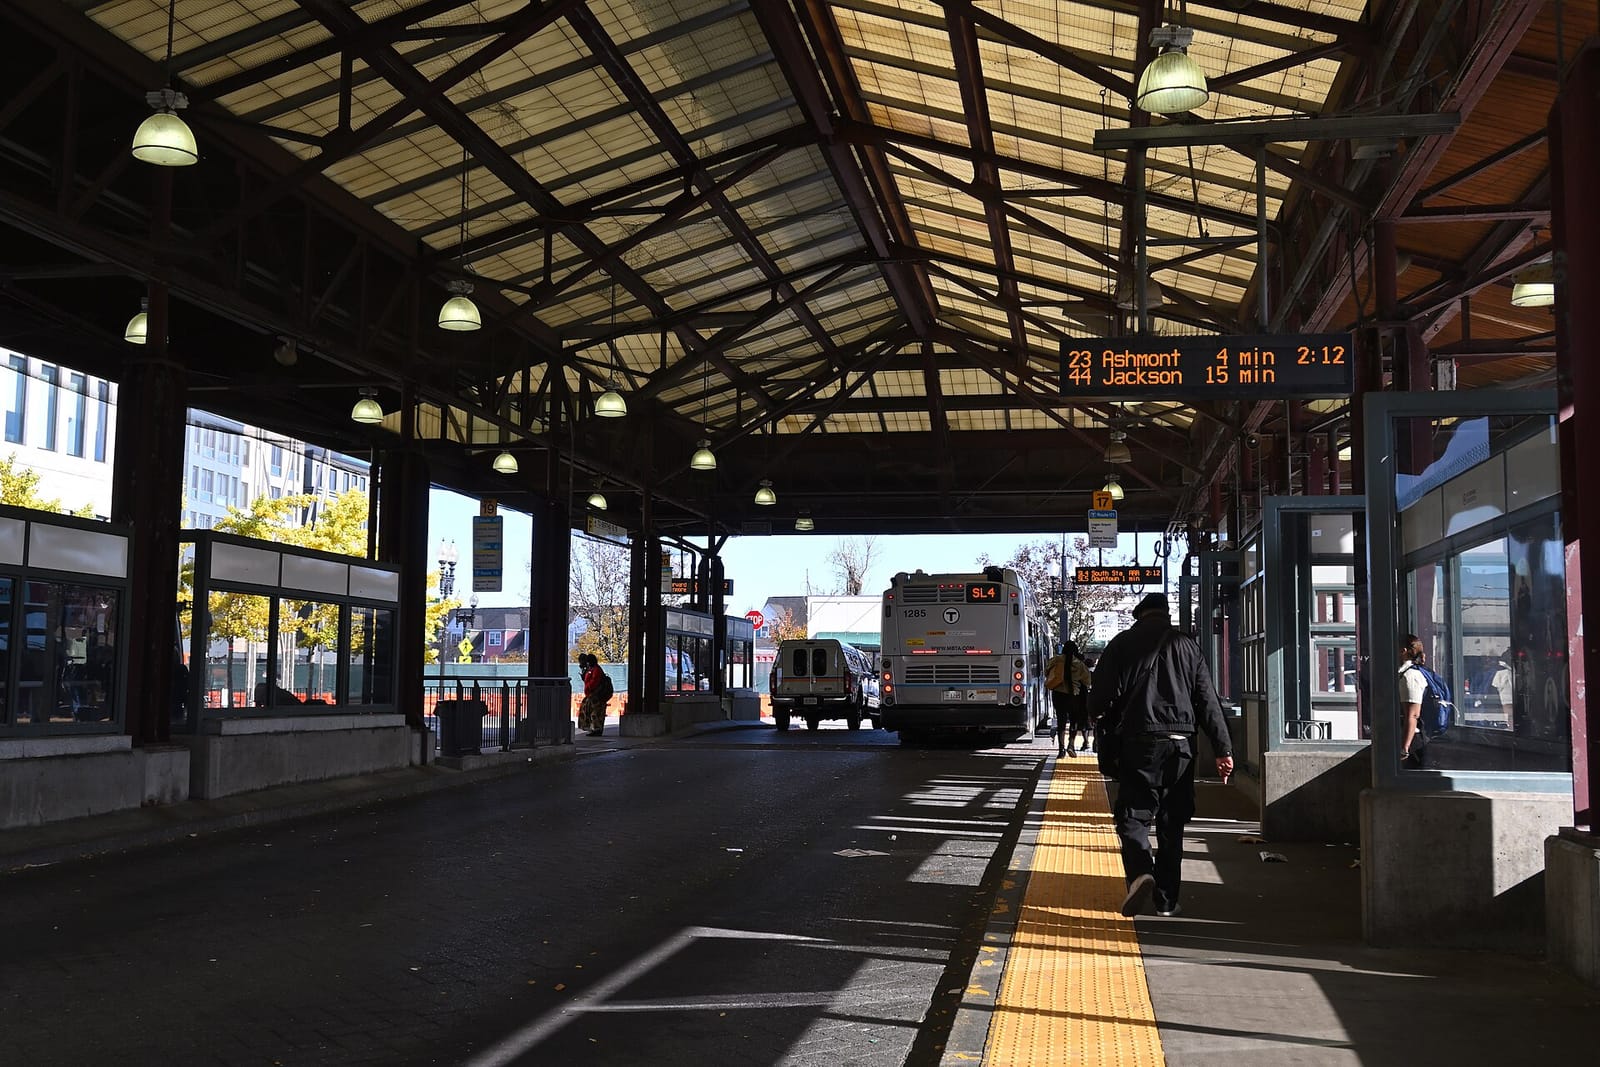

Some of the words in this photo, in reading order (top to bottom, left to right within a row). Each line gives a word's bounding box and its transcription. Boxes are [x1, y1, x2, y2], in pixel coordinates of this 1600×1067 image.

[1069, 350, 1092, 368] 23
[1102, 348, 1181, 368] Ashmont
[1216, 347, 1228, 366] 4
[1239, 347, 1275, 365] min
[1297, 346, 1345, 365] 2:12
[1068, 367, 1091, 385] 44
[1102, 367, 1183, 385] Jackson
[1206, 365, 1228, 384] 15
[1239, 365, 1275, 383] min
[1096, 497, 1109, 507] 17
[483, 503, 494, 514] 19
[1145, 569, 1161, 577] 2:12
[971, 587, 996, 598] SL4
[904, 609, 927, 618] 1285
